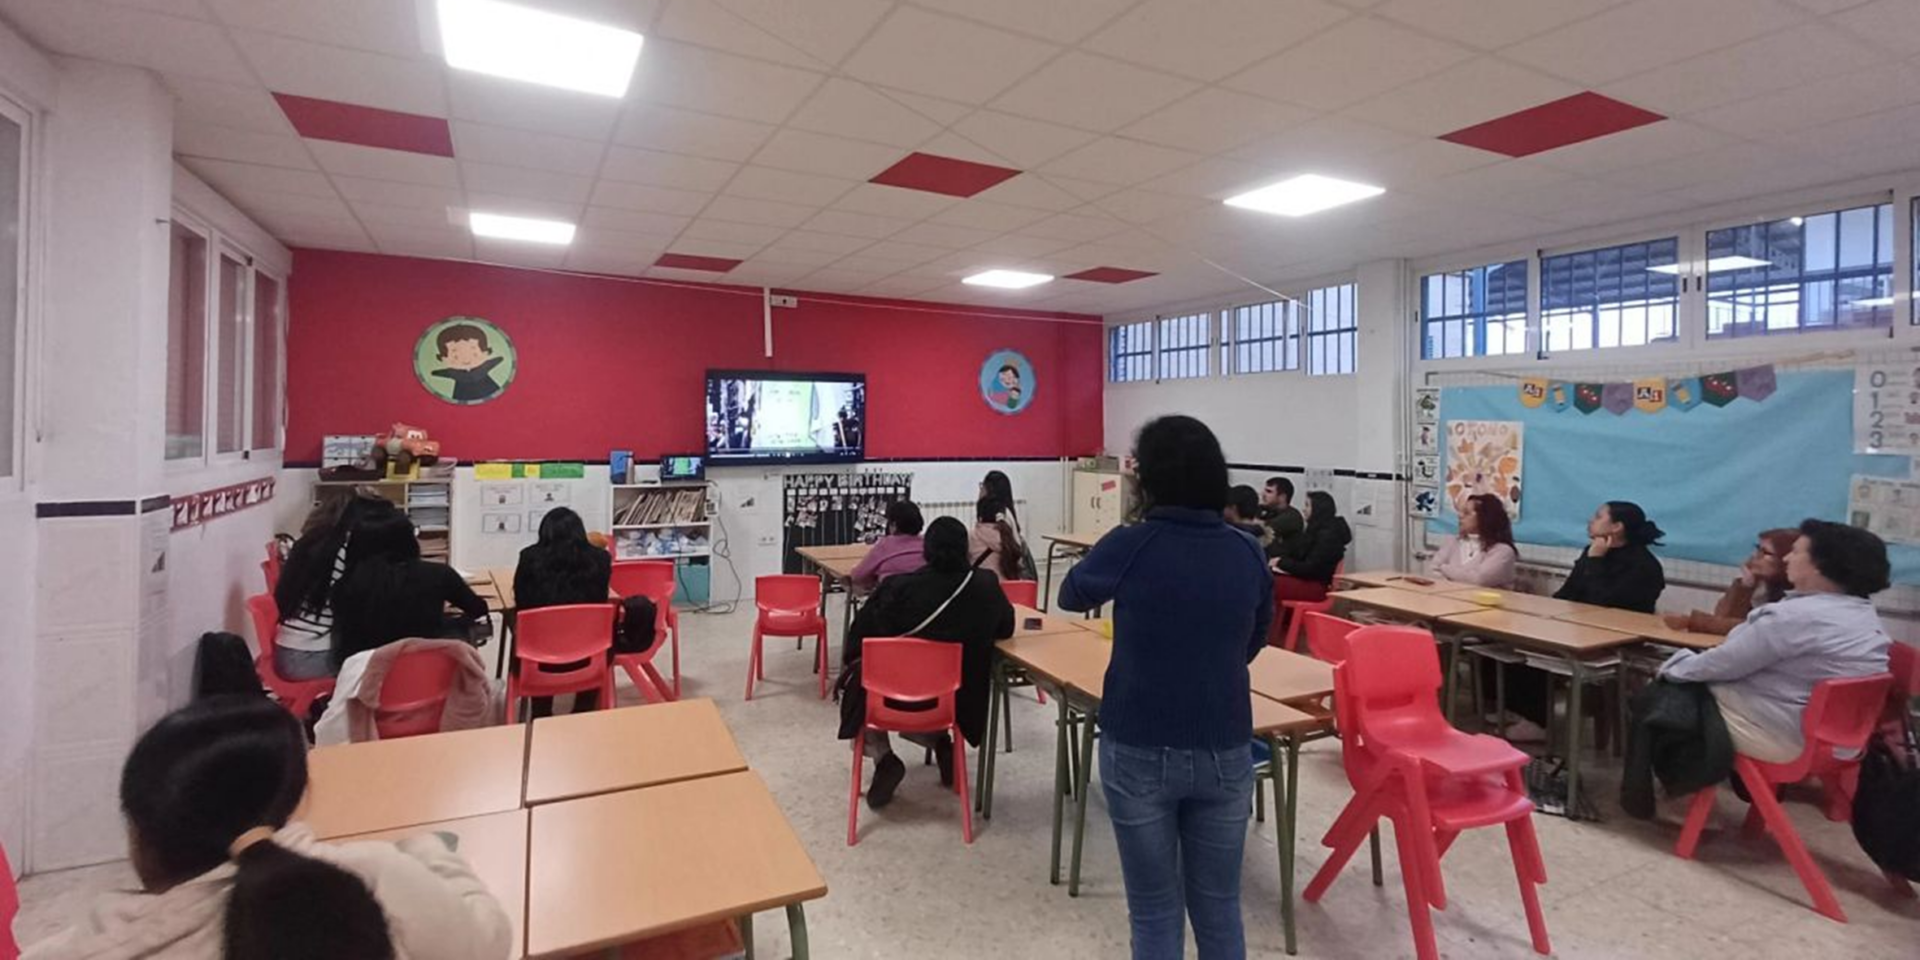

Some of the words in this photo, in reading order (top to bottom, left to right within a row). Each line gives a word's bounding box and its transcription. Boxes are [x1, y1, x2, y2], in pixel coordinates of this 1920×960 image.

[1870, 370, 1886, 388] 0
[1871, 391, 1878, 409] 1
[1869, 411, 1884, 429] 2
[1869, 431, 1882, 448] 3
[784, 474, 834, 488] HAPPY
